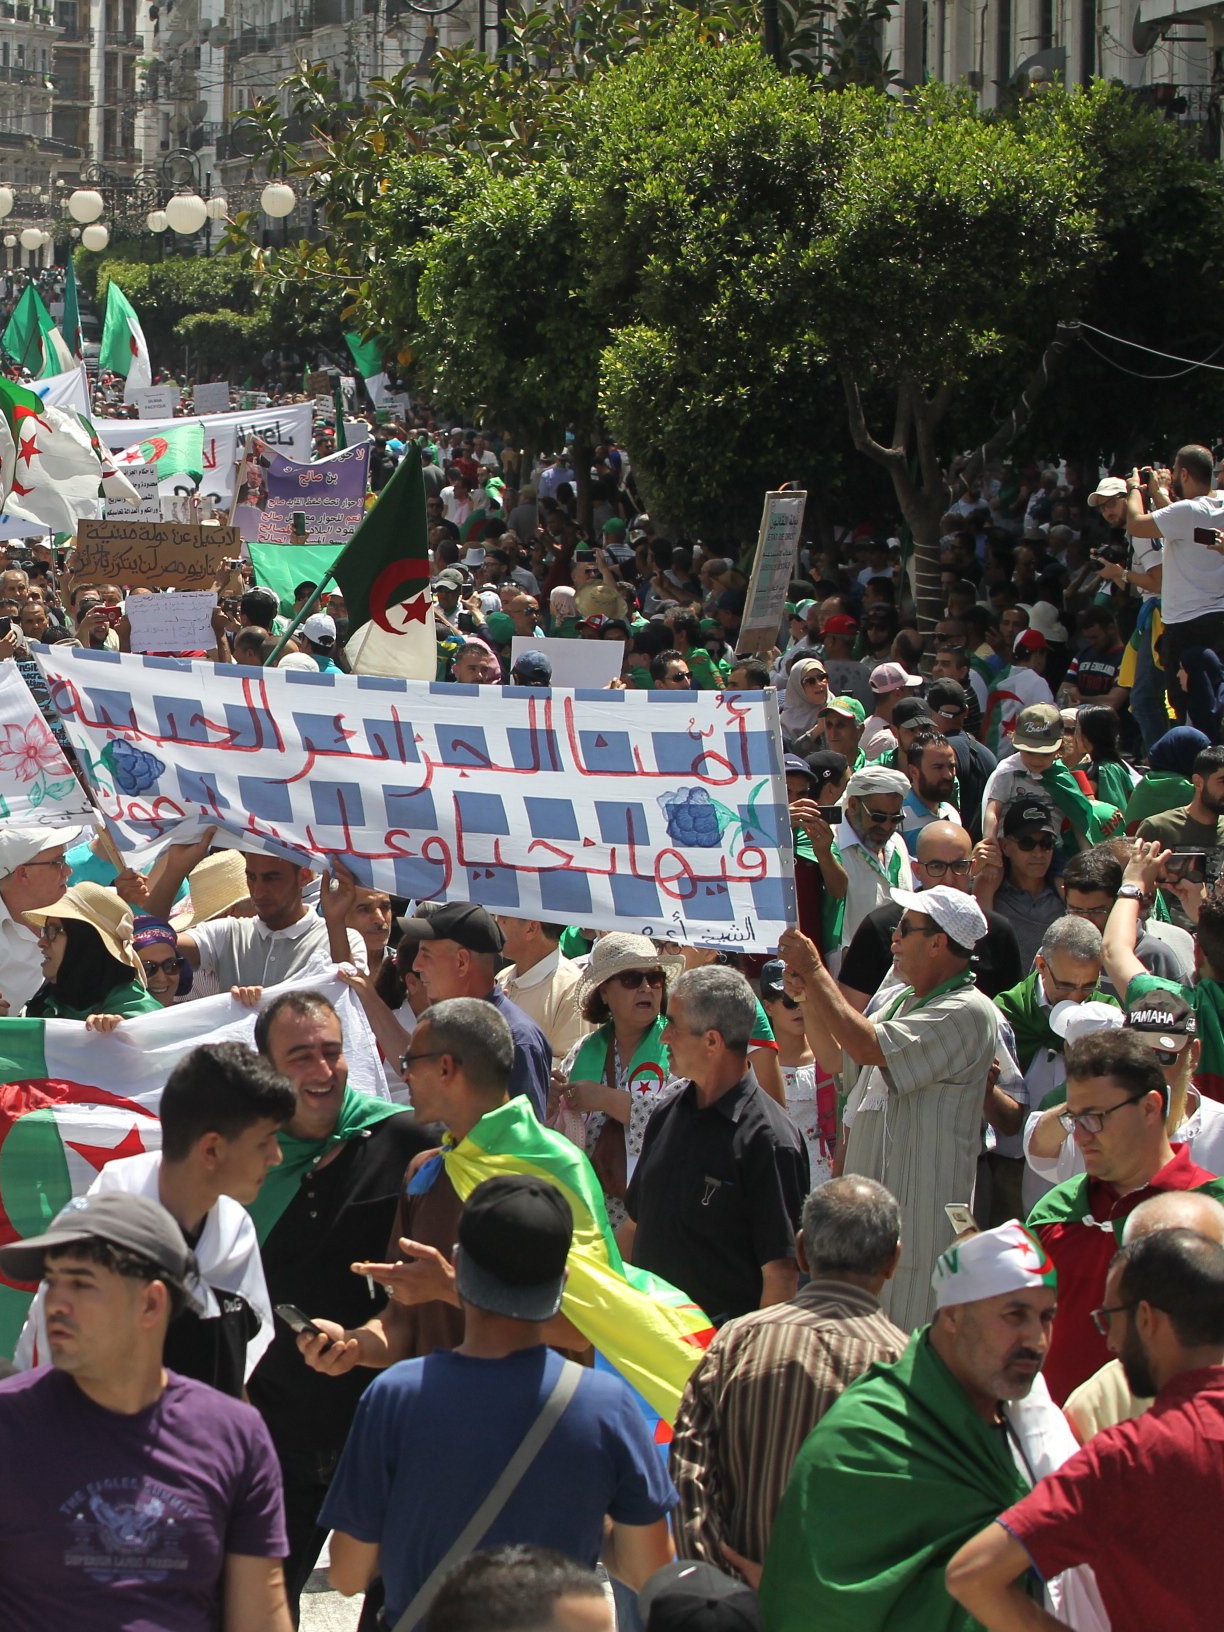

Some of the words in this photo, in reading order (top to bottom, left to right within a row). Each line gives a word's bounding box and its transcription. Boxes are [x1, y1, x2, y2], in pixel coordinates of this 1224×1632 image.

[298, 470, 324, 487] صالح
[326, 472, 338, 485] بن
[267, 496, 285, 508] صالح
[261, 511, 283, 522] صالح
[344, 514, 361, 526] نعم
[139, 523, 168, 547] دولة
[172, 527, 192, 546] عن
[452, 792, 616, 881] نحيا
[626, 806, 769, 901] فيها
[701, 916, 756, 943] الشيخ
[1129, 1009, 1175, 1026] YAMAHA
